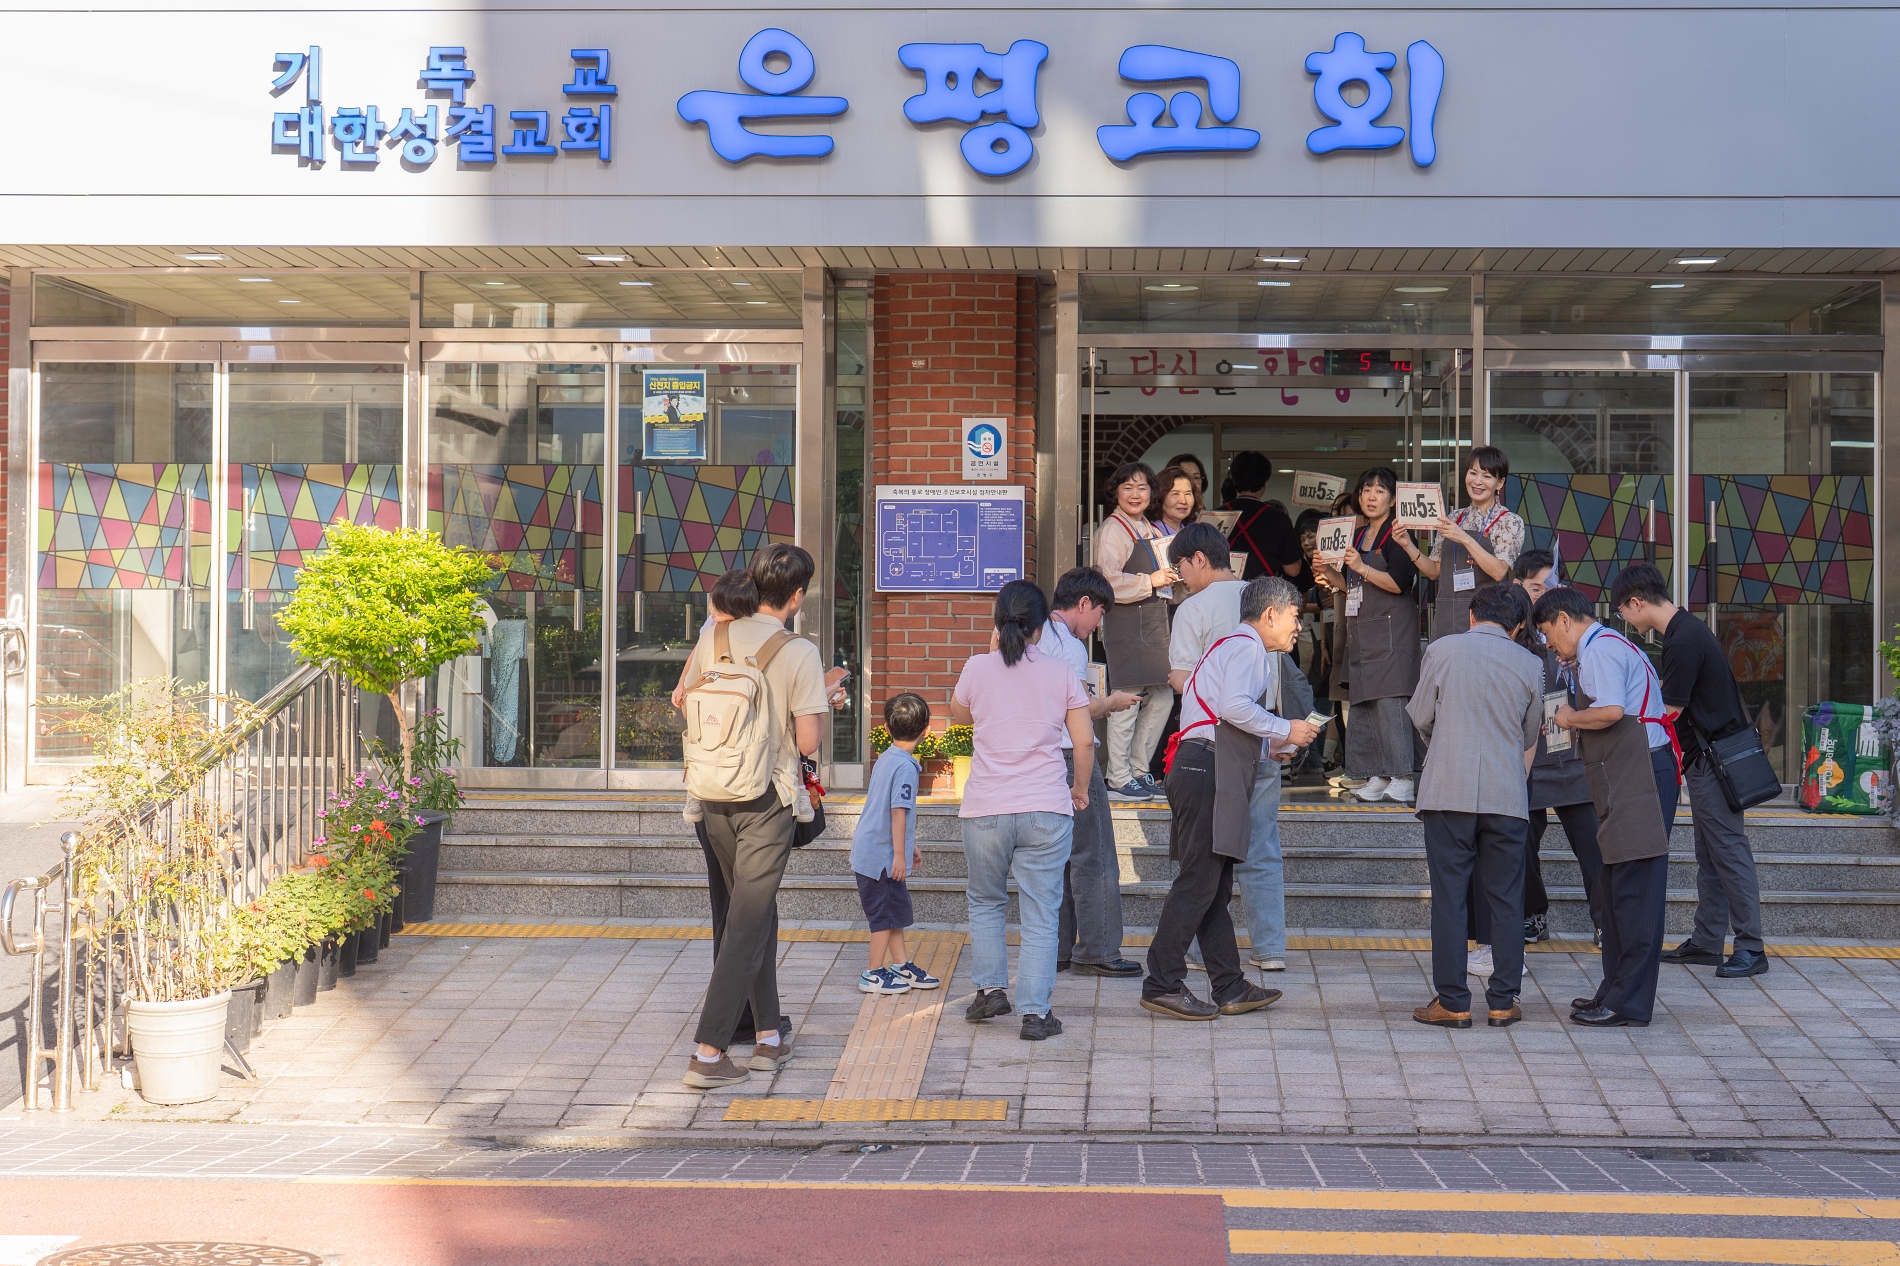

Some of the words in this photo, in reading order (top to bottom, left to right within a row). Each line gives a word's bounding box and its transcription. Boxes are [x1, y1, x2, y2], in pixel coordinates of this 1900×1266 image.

[676, 27, 1445, 177] 은평교회
[272, 104, 613, 164] 대한성결교회
[1299, 481, 1336, 501] 여자5조
[1400, 493, 1438, 519] 여자5조
[1320, 527, 1347, 552] 여자8조
[1824, 738, 1838, 783] coupang
[900, 783, 912, 801] 3
